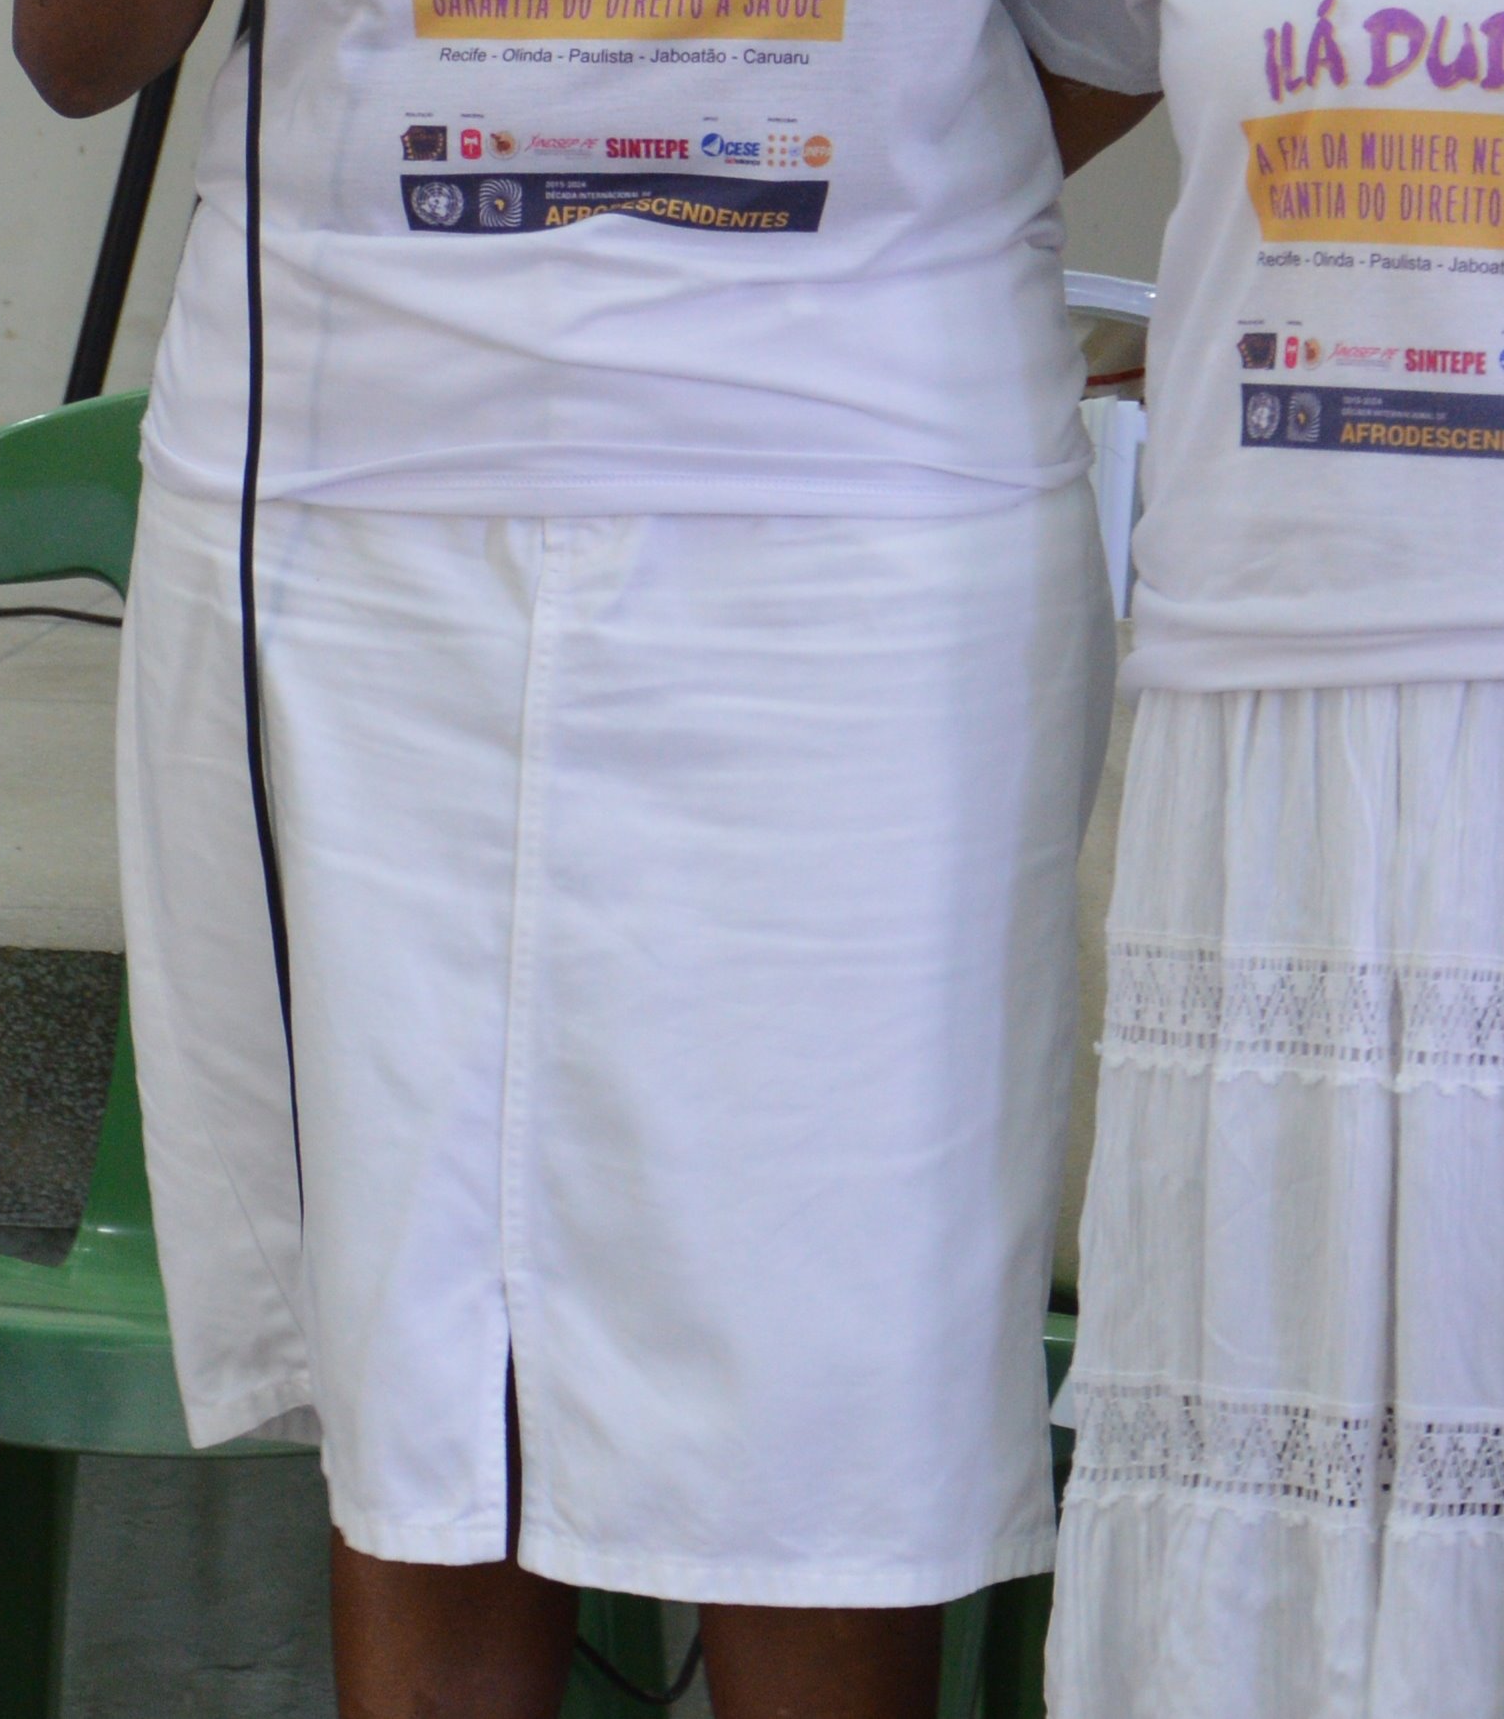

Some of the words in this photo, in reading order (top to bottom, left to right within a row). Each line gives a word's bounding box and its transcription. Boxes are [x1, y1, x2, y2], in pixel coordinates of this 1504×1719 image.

[439, 47, 488, 63] Recife
[502, 47, 553, 64] Olinda
[568, 48, 634, 65] Paulista
[650, 47, 727, 65] Jaboatão
[743, 48, 810, 65] Caruaru
[605, 137, 690, 159] SINTEPE
[724, 141, 761, 158] CESE
[1256, 142, 1274, 176] A
[1321, 132, 1349, 170] DA
[1361, 132, 1459, 174] MULHER
[1358, 181, 1387, 221] DO
[1399, 183, 1502, 228] DIREITO
[1369, 253, 1432, 271] Paulista
[1404, 347, 1486, 375] SINTEPE
